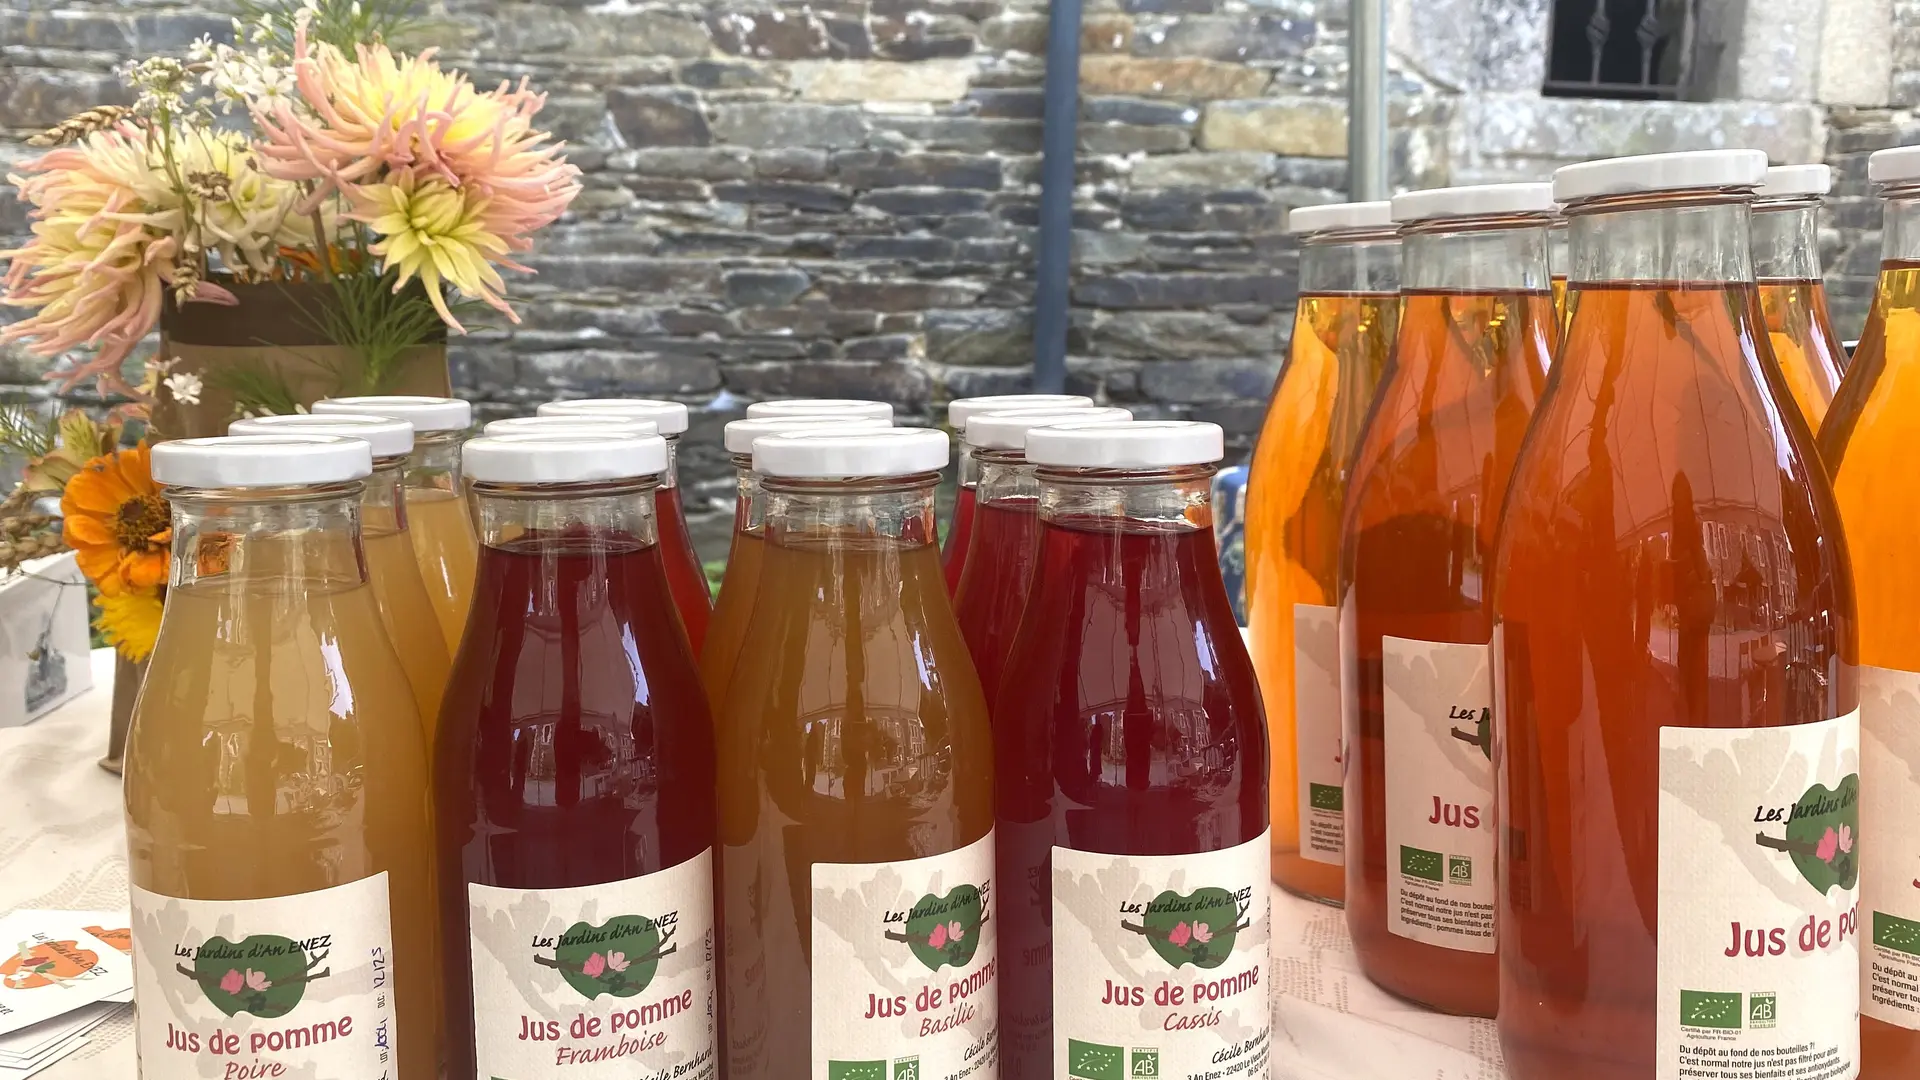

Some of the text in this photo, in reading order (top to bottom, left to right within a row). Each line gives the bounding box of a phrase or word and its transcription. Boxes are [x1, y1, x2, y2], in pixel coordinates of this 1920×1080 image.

[1449, 705, 1476, 720] Les
[1428, 795, 1480, 828] Jus
[1753, 806, 1785, 823] Les
[1785, 797, 1840, 825] Jardins
[1451, 864, 1469, 878] AB
[884, 879, 991, 924] Les Jardins d'An ENEZ
[1119, 886, 1252, 916] Les Jardins d'An ENEZ
[1400, 888, 1408, 897] Du
[1408, 891, 1425, 901] dépôt
[1434, 897, 1449, 906] fond
[1450, 899, 1458, 907] de
[1400, 897, 1414, 906] C'est
[1414, 901, 1435, 912] normal
[1435, 906, 1452, 915] notre
[1453, 909, 1463, 917] jus
[1400, 907, 1427, 918] préserver
[1427, 913, 1441, 922] tous
[1454, 918, 1482, 928] bienfaits
[1400, 915, 1432, 929] Ingrédients
[1436, 924, 1464, 935] pommes
[1465, 929, 1481, 937] issus
[1482, 930, 1492, 938] de
[532, 911, 678, 950] Les Jardins d'An ENEZ
[1724, 921, 1787, 958] Jus
[1799, 915, 1831, 952] de
[174, 934, 332, 961] Les Jardins d'An ENEZ
[1872, 962, 1918, 981] Du dépôt au
[1872, 972, 1919, 992] C'est normal
[865, 993, 906, 1019] Jus
[915, 985, 942, 1012] de
[949, 956, 996, 1004] pomme
[1101, 965, 1259, 1007] Jus de pomme
[1872, 984, 1912, 1000] préserver
[1751, 1003, 1772, 1019] AB
[1872, 993, 1915, 1012] Ingrédients
[518, 1015, 560, 1041] Jus
[570, 1013, 602, 1039] de
[611, 988, 692, 1033] pomme
[919, 1001, 976, 1037] Basilic
[1163, 1007, 1223, 1031] Cassis
[166, 1022, 200, 1053] Jus
[209, 1028, 241, 1055] de
[251, 1016, 353, 1053] pomme
[556, 1029, 669, 1066] Framboise
[964, 1036, 985, 1061] Cécile
[1212, 1042, 1243, 1064] Cécile
[1679, 1044, 1691, 1055] Du
[1692, 1046, 1717, 1057] dépôt
[1718, 1048, 1729, 1057] au
[1730, 1047, 1748, 1057] fond
[1750, 1048, 1760, 1057] de
[1761, 1048, 1775, 1057] nos
[1776, 1044, 1809, 1056] bouteilles
[1679, 1046, 1838, 1070] C'est normal notre jus n'est pas filtré pour ainsi
[223, 1058, 287, 1080] Poire
[1133, 1059, 1154, 1075] AB
[1205, 1071, 1221, 1080] Enez
[1226, 1061, 1243, 1076] 22420
[1244, 1059, 1250, 1068] Le
[1679, 1056, 1841, 1079] préserver tous ses bienfaits et ses antioxydants
[1830, 1061, 1851, 1076] biologique
